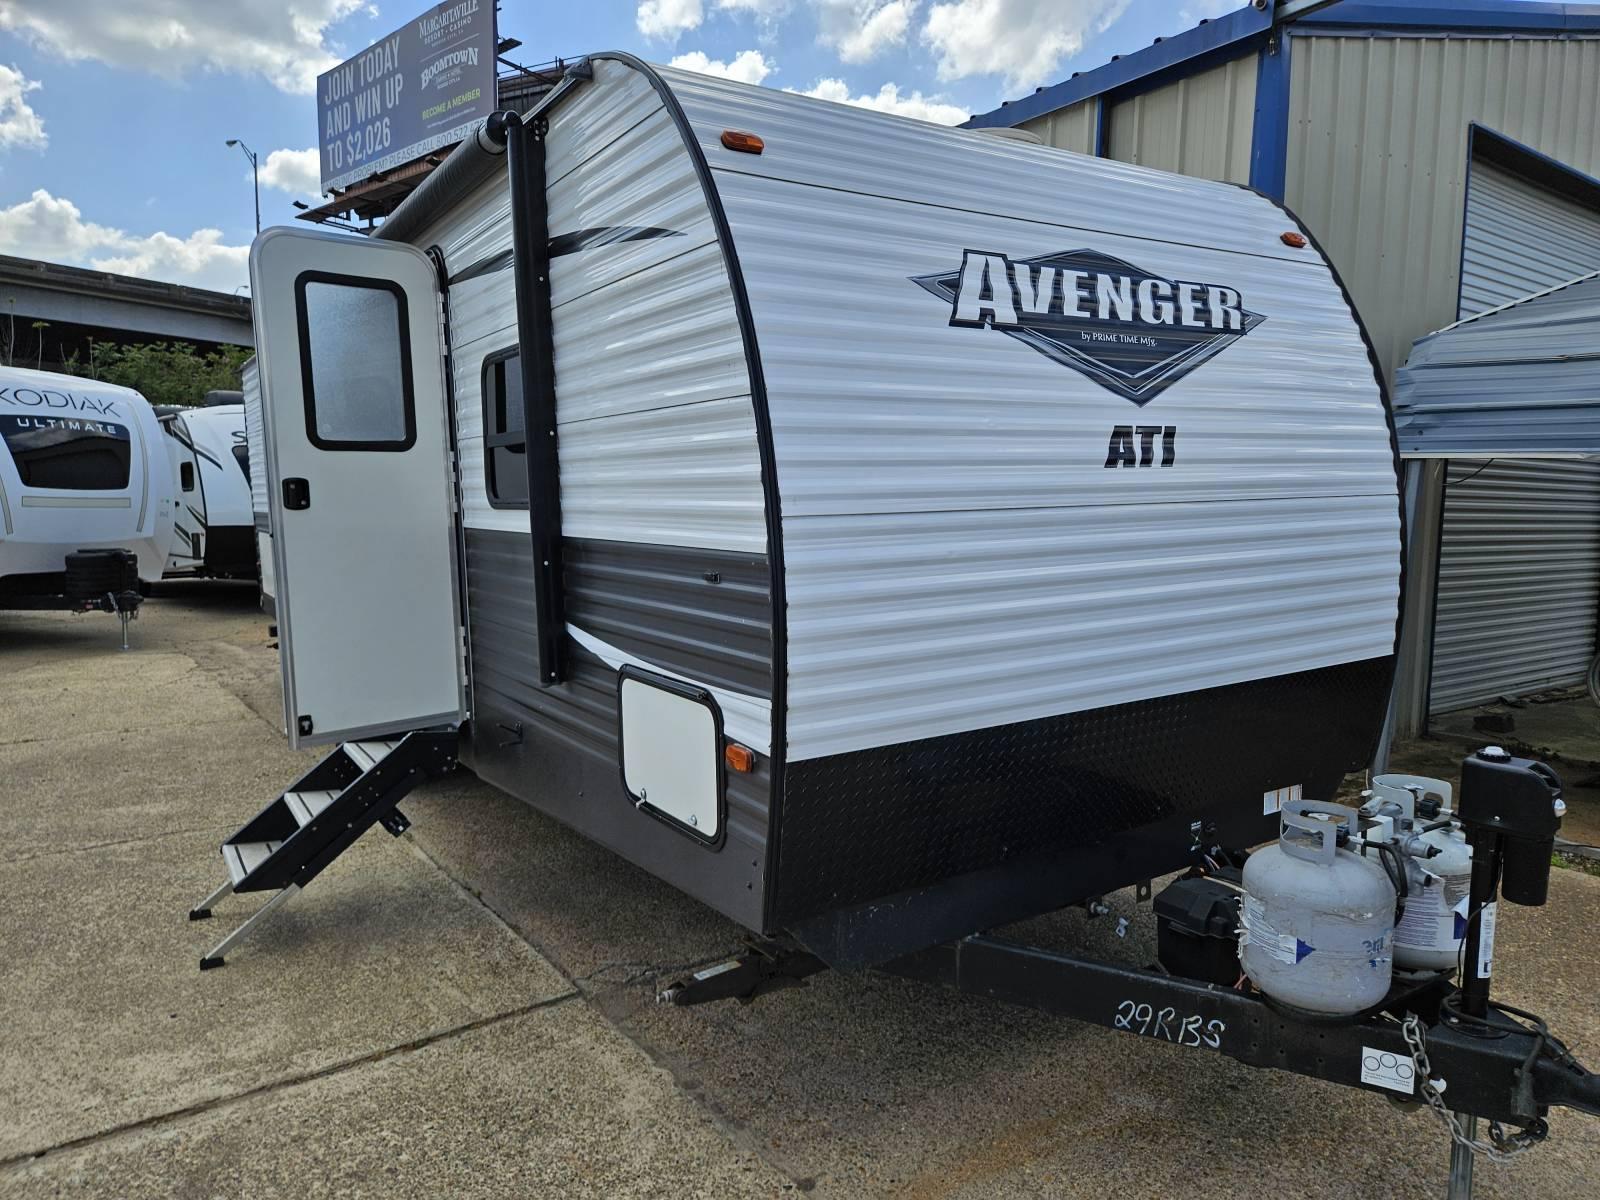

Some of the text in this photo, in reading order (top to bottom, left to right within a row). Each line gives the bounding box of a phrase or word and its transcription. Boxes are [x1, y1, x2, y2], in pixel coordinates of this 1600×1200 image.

[418, 0, 479, 39] MARGARITAVILLE
[450, 16, 472, 32] CASINO
[325, 35, 400, 105] JOIN TODAY
[421, 47, 479, 90] BOOMTOWN
[327, 102, 351, 139] AND
[355, 84, 381, 124] WIN
[385, 72, 403, 109] UP
[422, 102, 447, 120] BECOME
[447, 100, 452, 111] A
[452, 88, 480, 108] MEMBER
[327, 140, 343, 172] TO
[346, 117, 391, 166] $2,026
[389, 145, 415, 166] PLEASE
[417, 141, 435, 155] CALL
[950, 249, 1247, 335] AVENGER
[1081, 331, 1091, 342] by
[1092, 332, 1118, 342] PRIME
[1119, 334, 1139, 344] TIME
[0, 388, 121, 418] KODIAK
[17, 417, 117, 434] ULTIMATE
[1104, 426, 1176, 468] ATI
[1114, 1000, 1225, 1049] 29RBS
